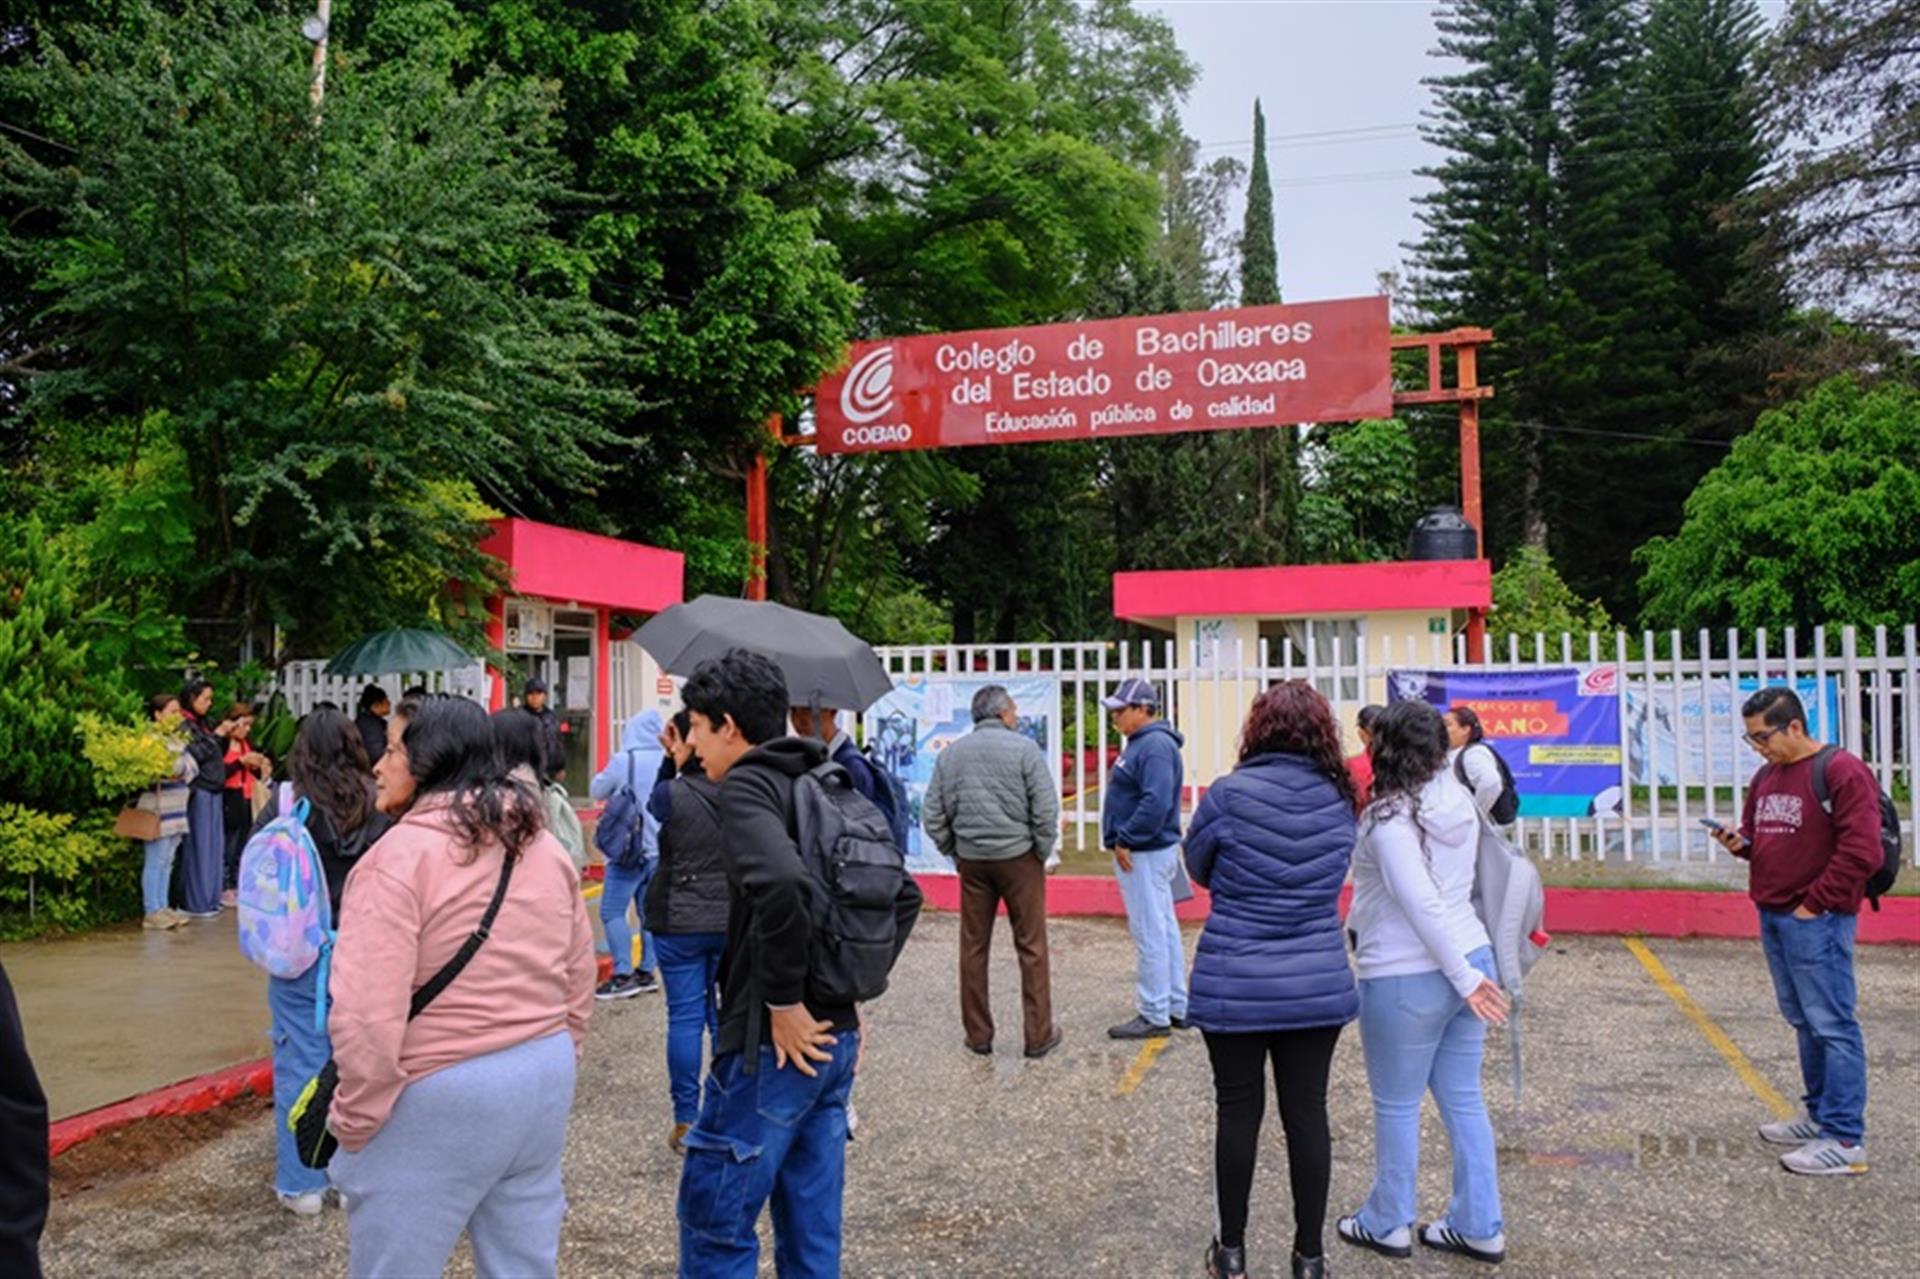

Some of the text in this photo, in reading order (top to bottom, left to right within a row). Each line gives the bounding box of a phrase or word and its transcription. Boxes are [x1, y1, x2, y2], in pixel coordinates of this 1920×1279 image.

[936, 320, 1313, 374] Colegio de Bachilleres
[951, 357, 1307, 405] del Estado de Oaxaca
[842, 423, 913, 446] COBAO
[985, 393, 1276, 434] Educación pública de calidad
